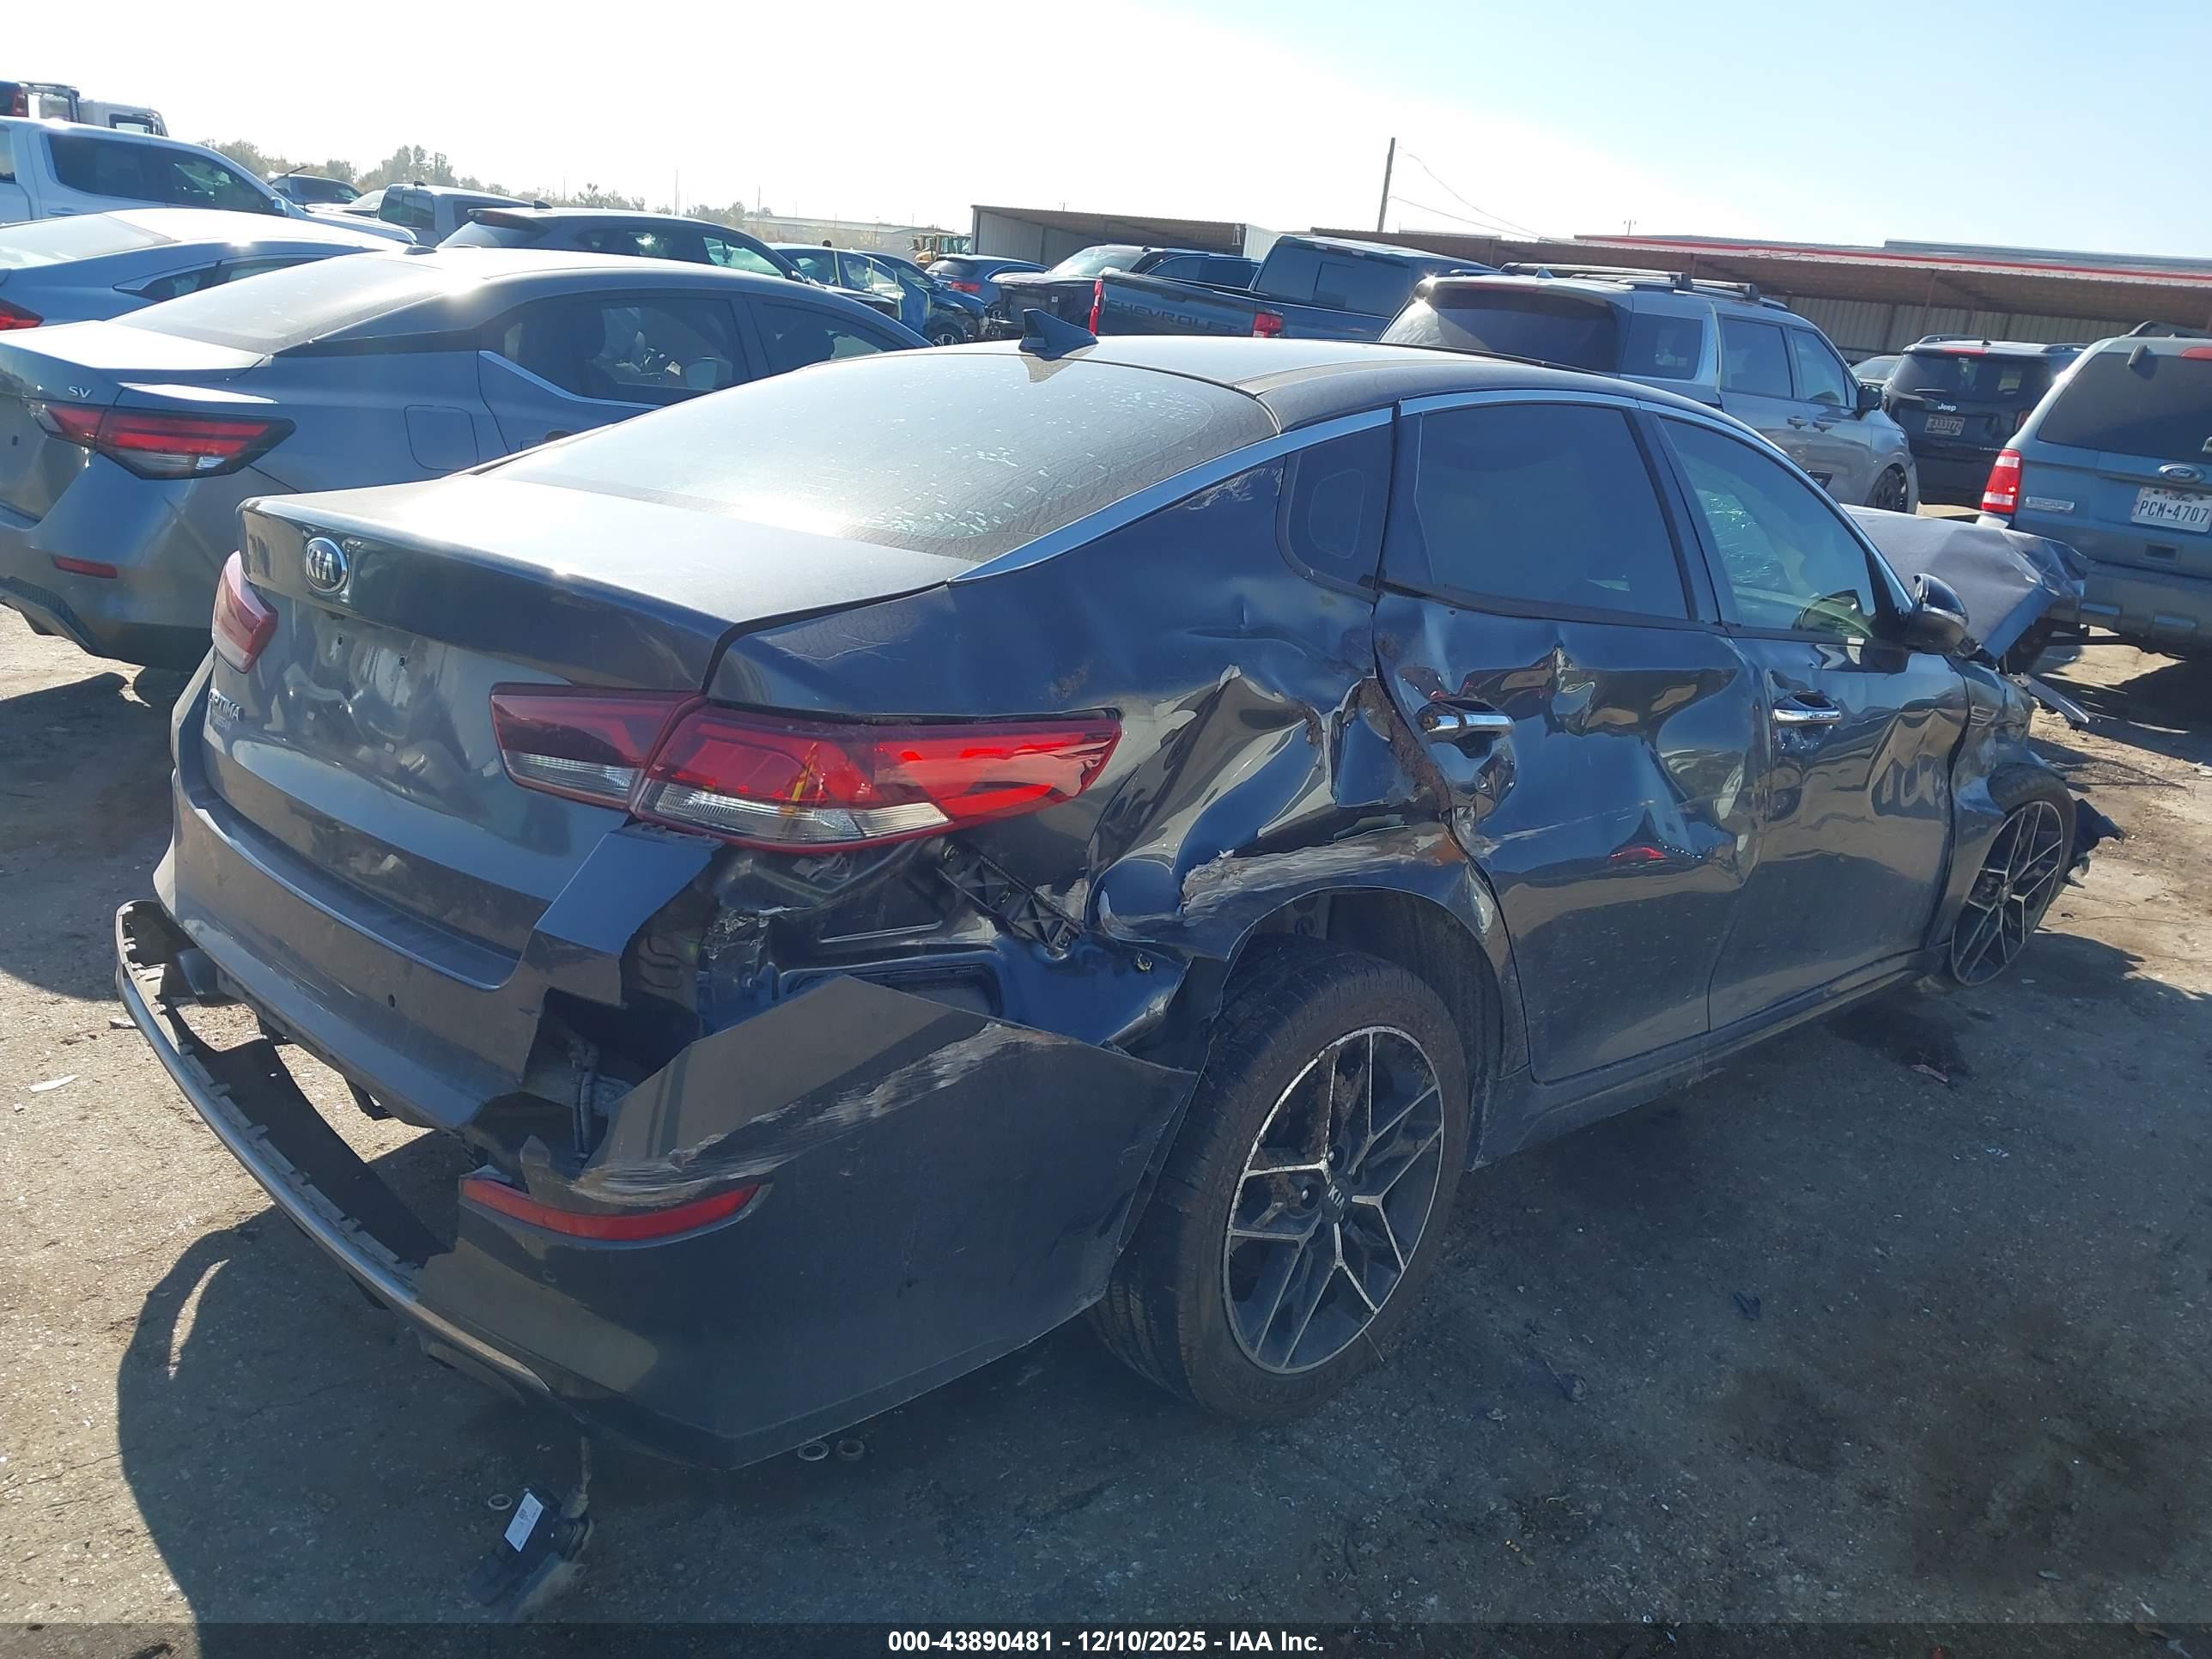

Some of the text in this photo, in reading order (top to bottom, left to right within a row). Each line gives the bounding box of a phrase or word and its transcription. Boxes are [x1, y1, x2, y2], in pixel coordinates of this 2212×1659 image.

[1107, 300, 1238, 331] CHEVROLET
[69, 386, 92, 398] SV
[1937, 403, 1957, 412] Jeep
[1328, 1185, 1345, 1211] KIA
